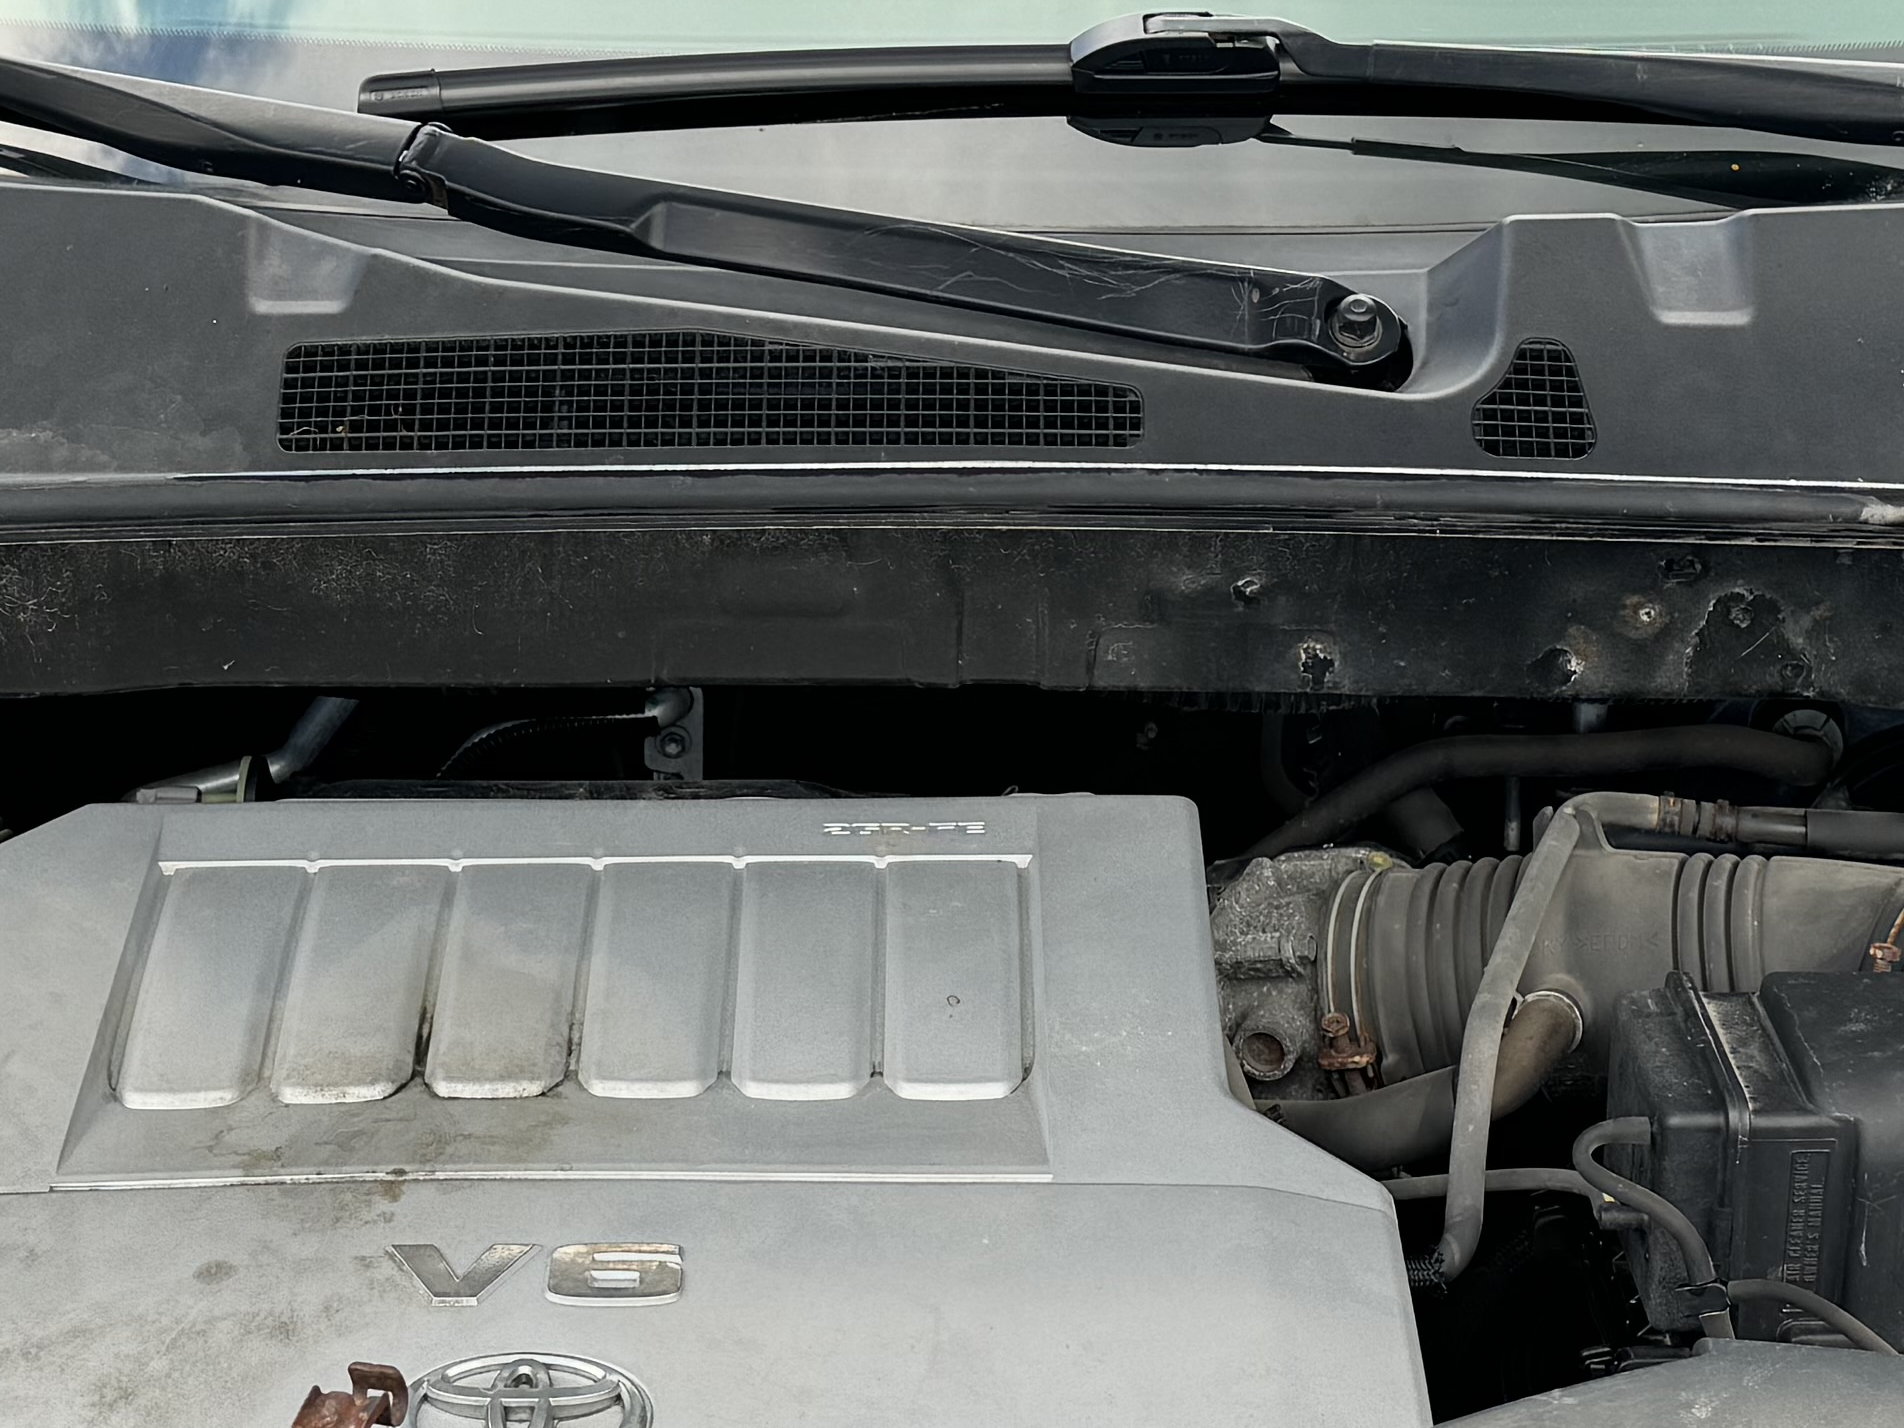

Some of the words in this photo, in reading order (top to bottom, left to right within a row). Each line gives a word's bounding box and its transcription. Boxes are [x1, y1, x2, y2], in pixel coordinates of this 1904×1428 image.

[1787, 1209, 1806, 1257] CLEANER
[1803, 1232, 1820, 1281] OWNER'S
[385, 1242, 684, 1307] V6
[1786, 1264, 1802, 1281] AIR
